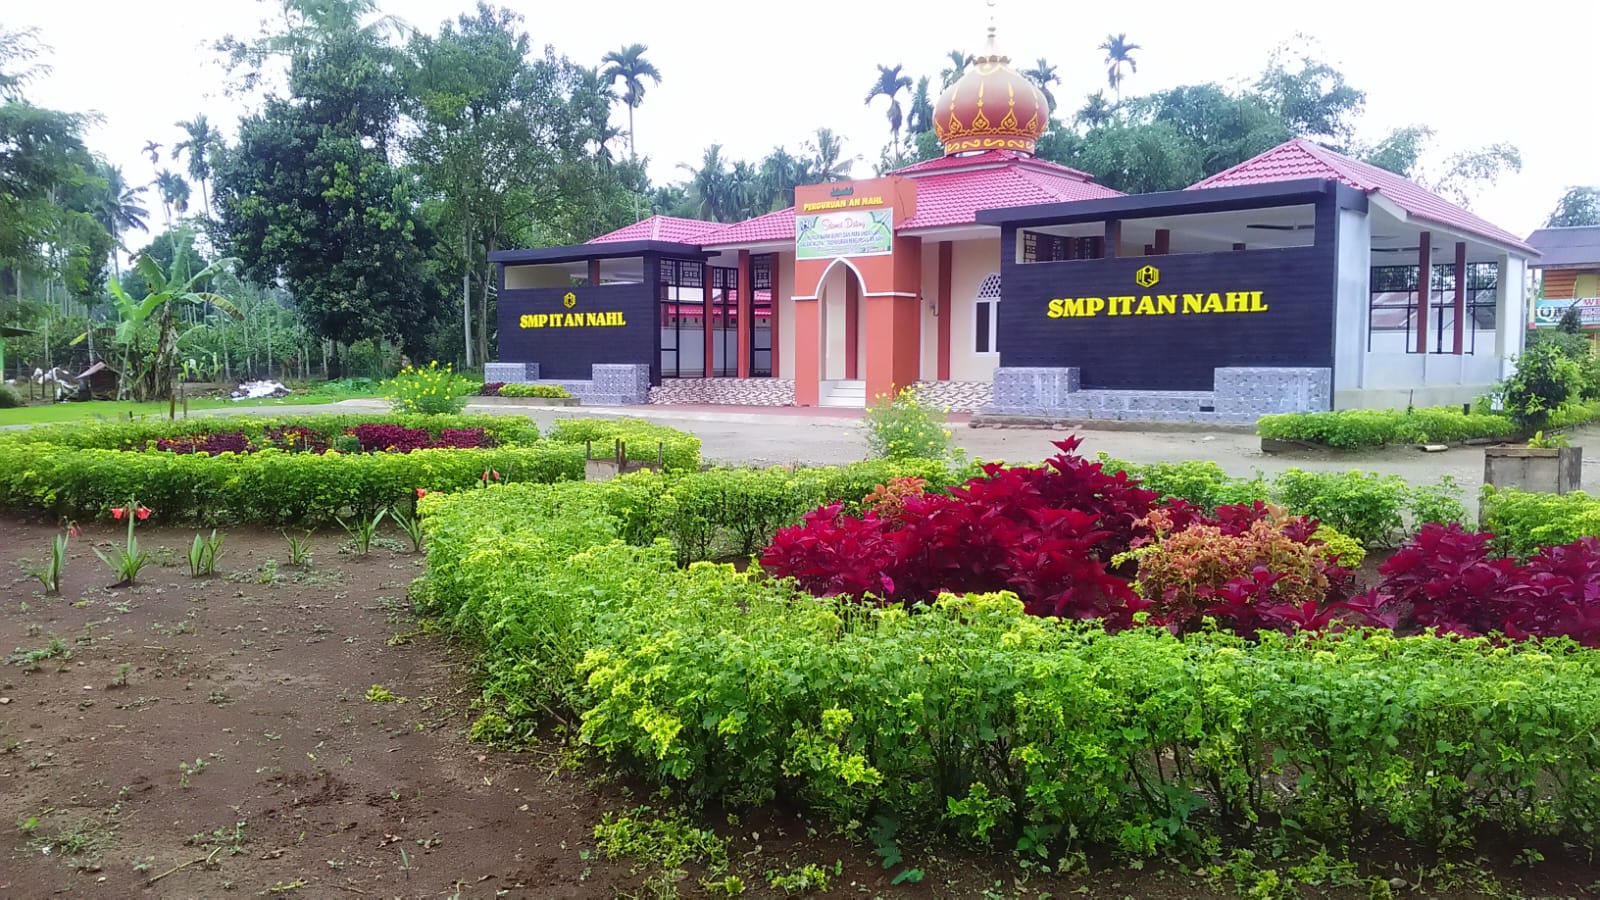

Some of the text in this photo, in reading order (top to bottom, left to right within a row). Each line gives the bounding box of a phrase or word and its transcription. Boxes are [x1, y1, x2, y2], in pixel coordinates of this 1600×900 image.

[861, 197, 883, 205] NAHL
[1047, 291, 1268, 318] SMP IT AN NAHL
[519, 312, 626, 329] SMP IT AN NAHL
